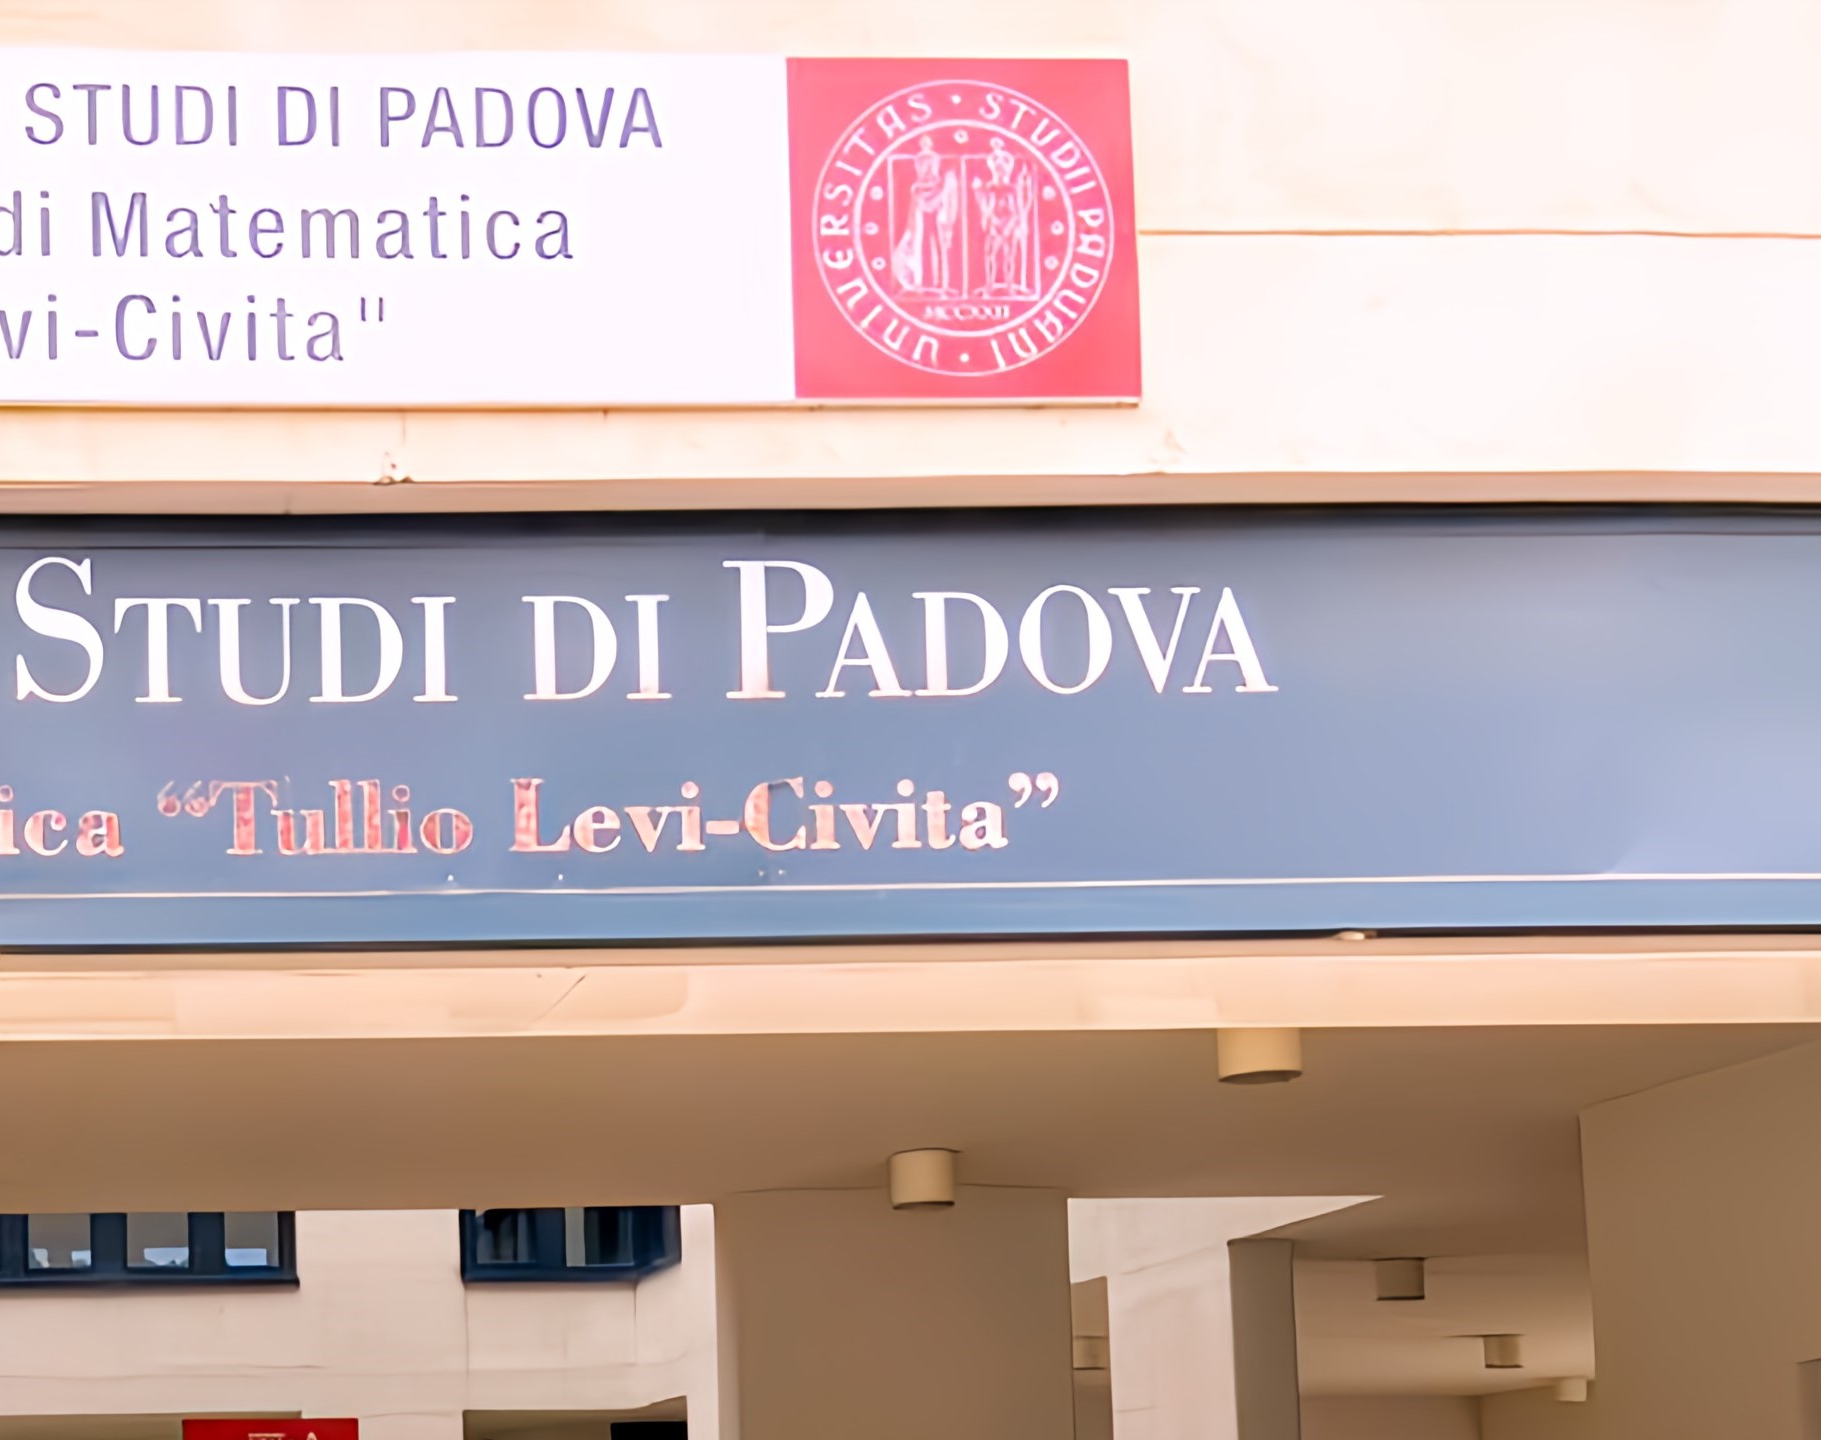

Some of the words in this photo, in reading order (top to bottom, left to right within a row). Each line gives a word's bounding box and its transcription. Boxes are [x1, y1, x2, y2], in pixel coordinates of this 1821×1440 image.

[23, 82, 239, 147] STUDI
[276, 85, 341, 148] DI
[379, 86, 664, 150] PADOVA
[90, 191, 575, 261] Matematica
[14, 556, 460, 706] STUDI
[521, 594, 673, 701] DI
[722, 560, 1281, 700] PADOVA
